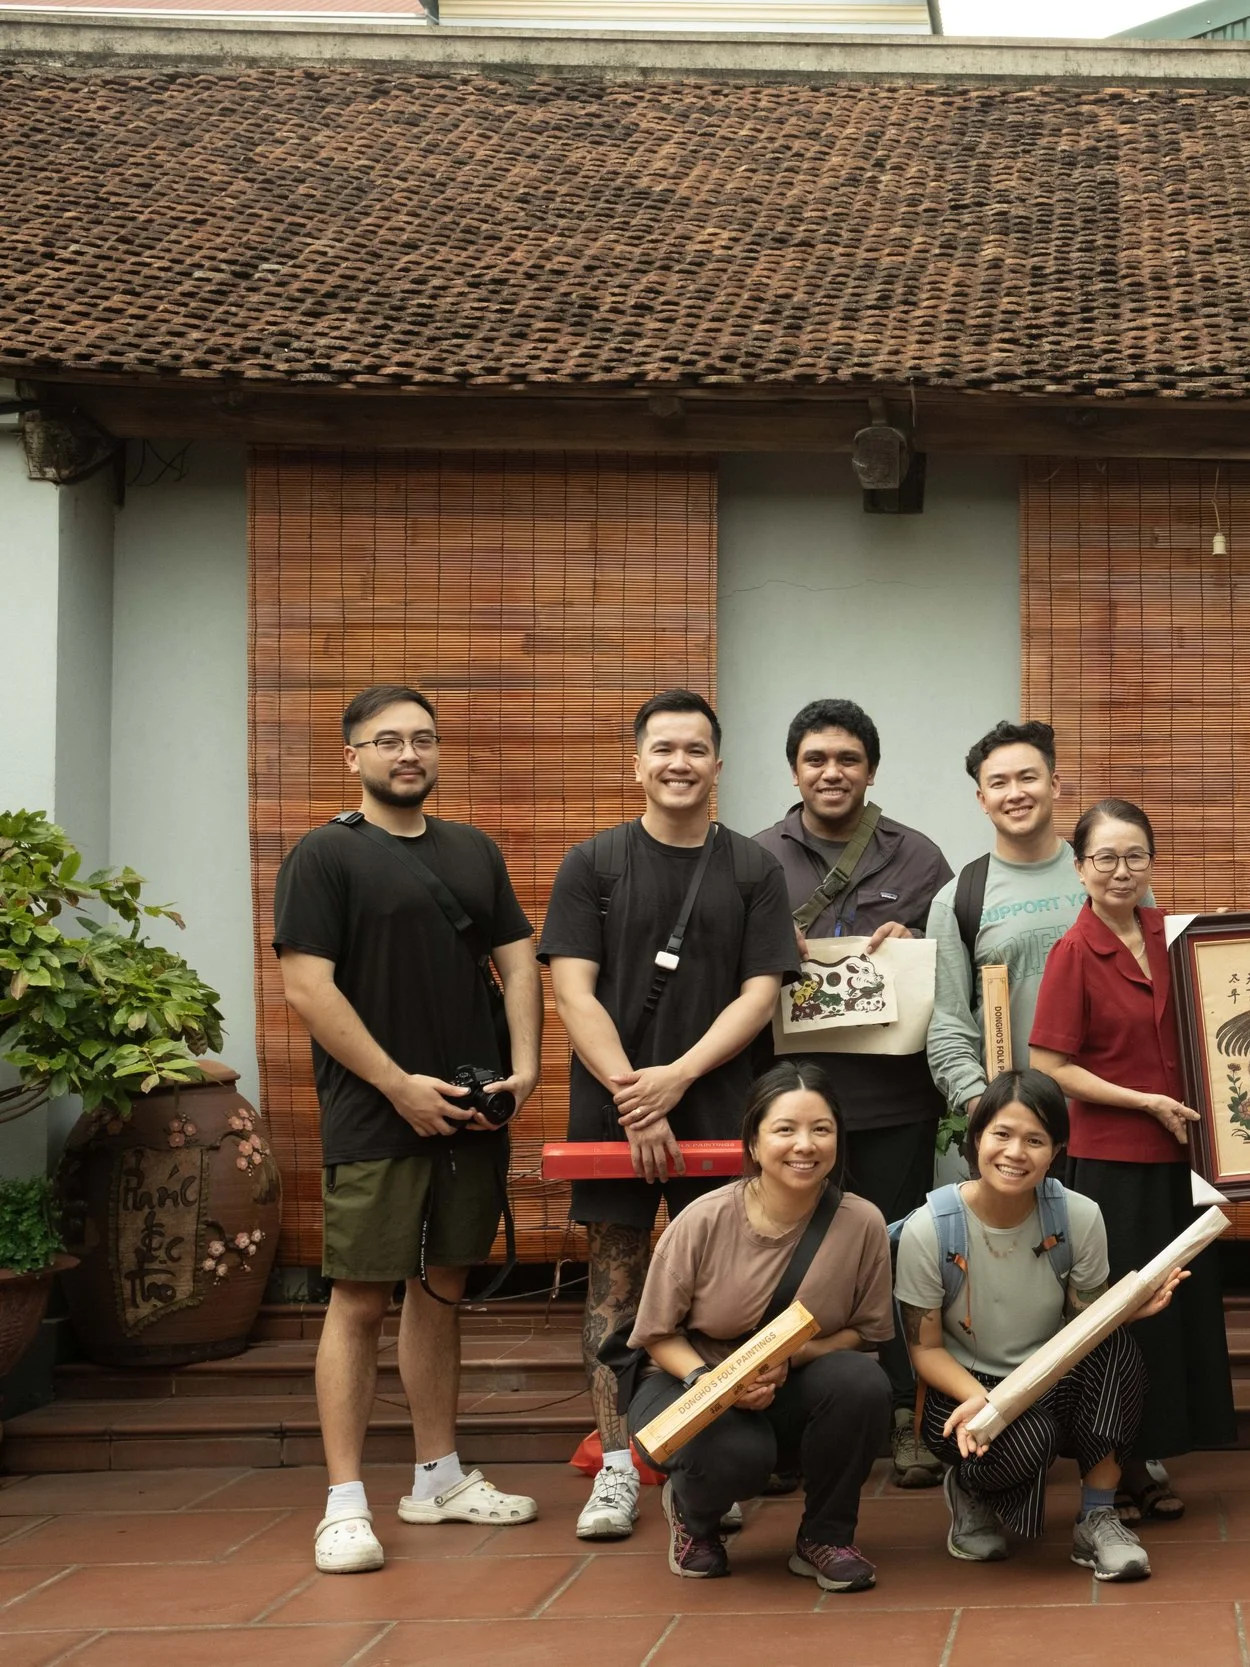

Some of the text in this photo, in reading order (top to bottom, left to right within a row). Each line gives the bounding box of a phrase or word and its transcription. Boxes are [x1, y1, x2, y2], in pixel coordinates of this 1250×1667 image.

[994, 1006, 1004, 1045] DONGHO'S
[996, 1046, 1004, 1064] FOLK
[678, 1331, 777, 1415] DONGHO'S FOLK PAINTINGS
